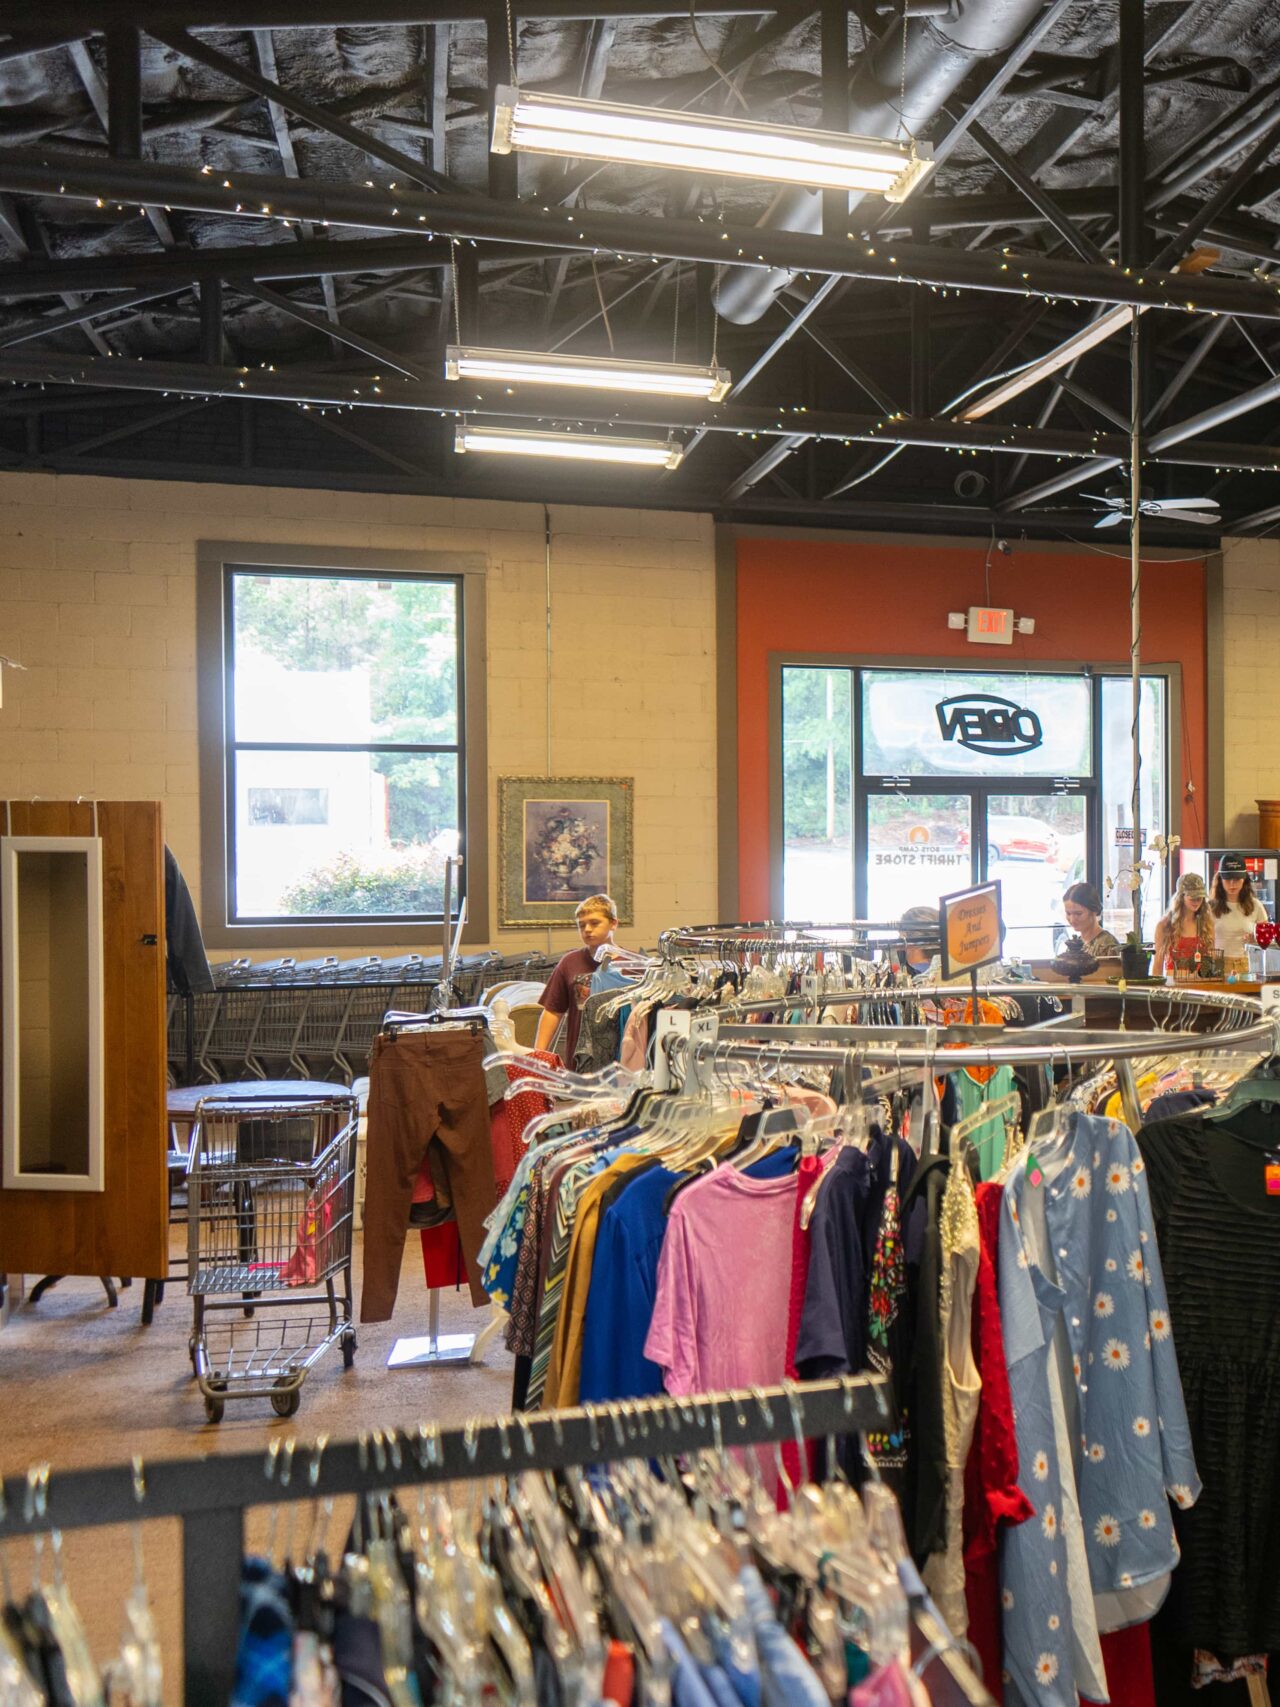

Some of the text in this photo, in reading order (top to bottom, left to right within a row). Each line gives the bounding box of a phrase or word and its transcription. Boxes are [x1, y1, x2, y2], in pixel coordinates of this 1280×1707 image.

[978, 609, 1007, 633] EXIT
[958, 904, 986, 921] Dresses
[964, 916, 983, 937] And
[959, 934, 990, 955] Jumpers
[806, 979, 812, 989] M
[1273, 989, 1280, 999] S
[669, 1015, 677, 1026] L
[697, 1021, 712, 1033] XL
